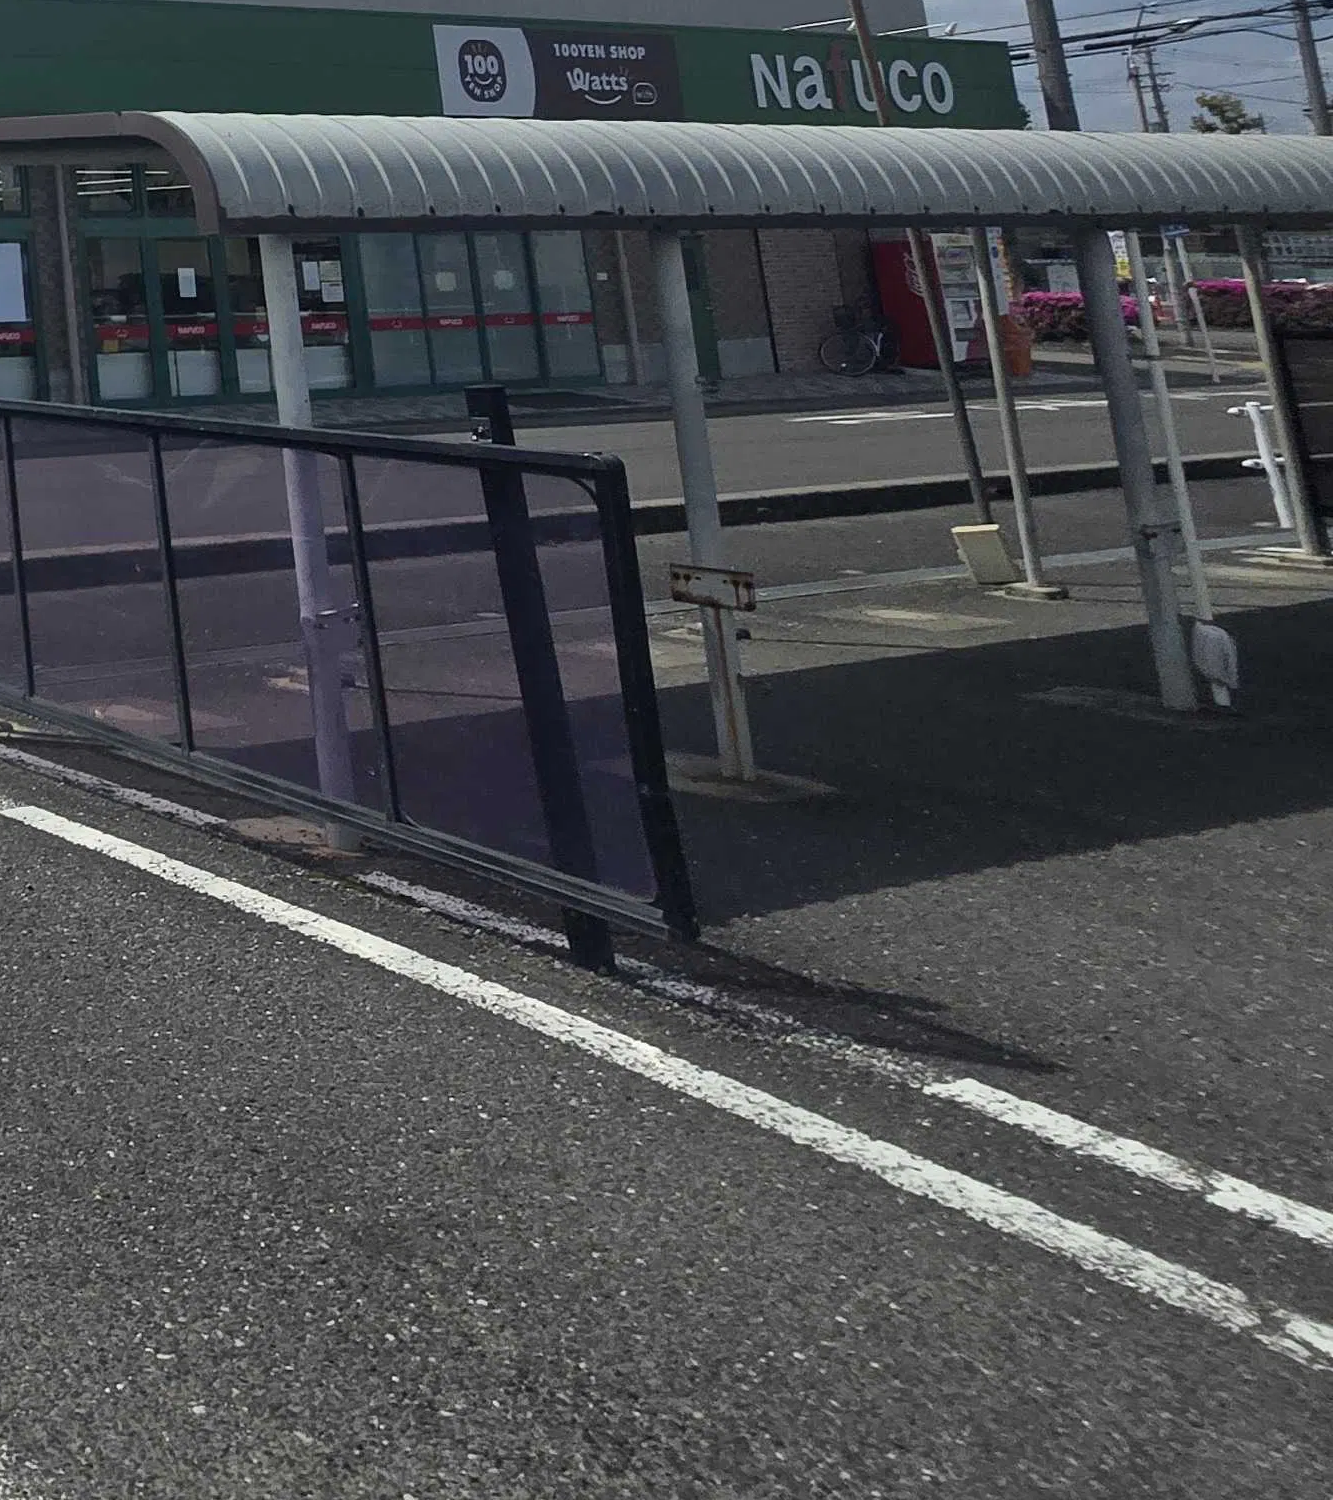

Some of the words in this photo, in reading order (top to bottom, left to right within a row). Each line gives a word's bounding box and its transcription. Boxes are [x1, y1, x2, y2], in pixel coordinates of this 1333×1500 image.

[553, 43, 606, 59] 100YEN
[610, 46, 646, 60] SHOP
[463, 54, 500, 76] 100
[464, 74, 482, 97] YEN
[565, 67, 629, 92] Watts
[749, 41, 955, 115] Nafuco
